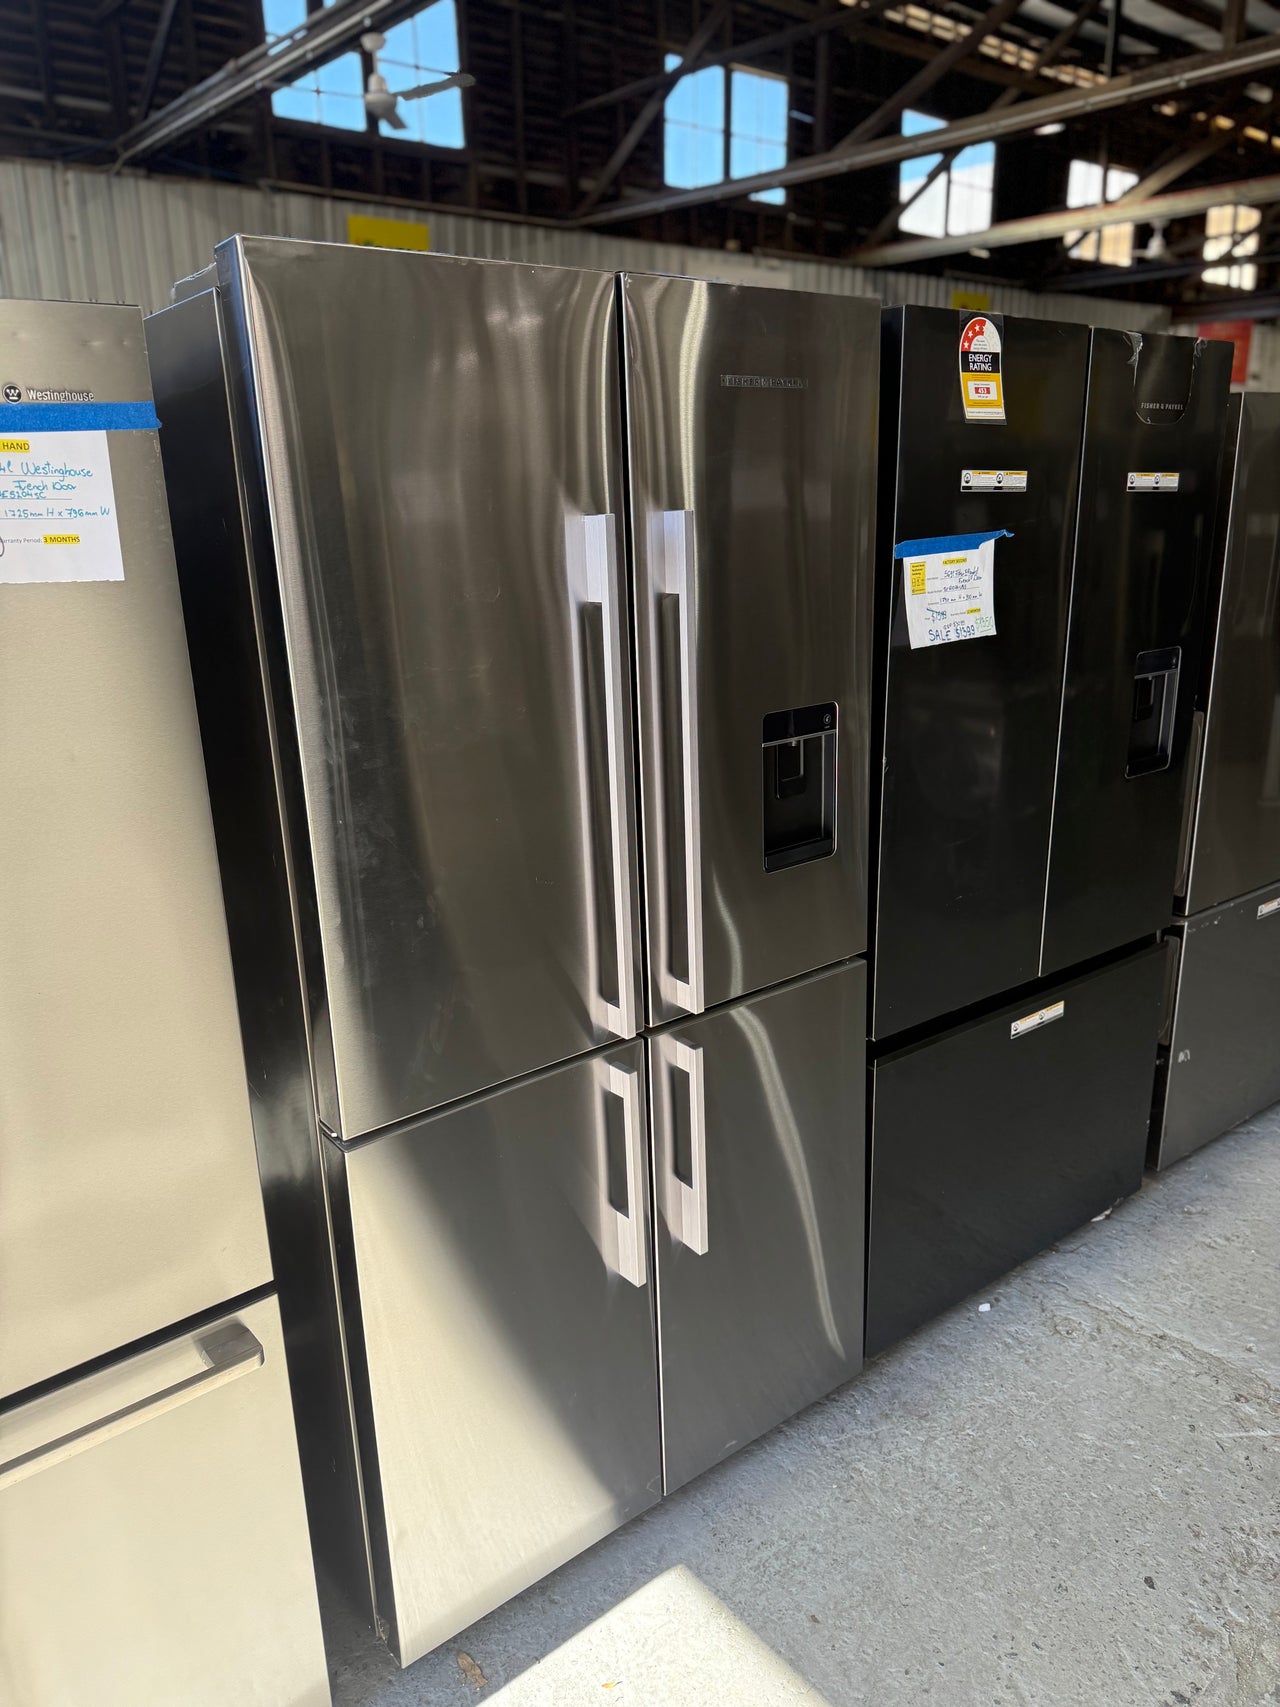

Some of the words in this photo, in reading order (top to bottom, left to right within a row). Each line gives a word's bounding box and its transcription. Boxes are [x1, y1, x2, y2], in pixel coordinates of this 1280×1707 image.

[968, 353, 993, 363] ENERGY
[969, 363, 992, 372] RATING
[26, 389, 94, 402] Westinghouse
[2, 442, 30, 450] HAND
[21, 461, 93, 482] Westinghouse
[46, 507, 54, 517] H
[100, 506, 110, 516] W
[928, 629, 951, 641] SALE
